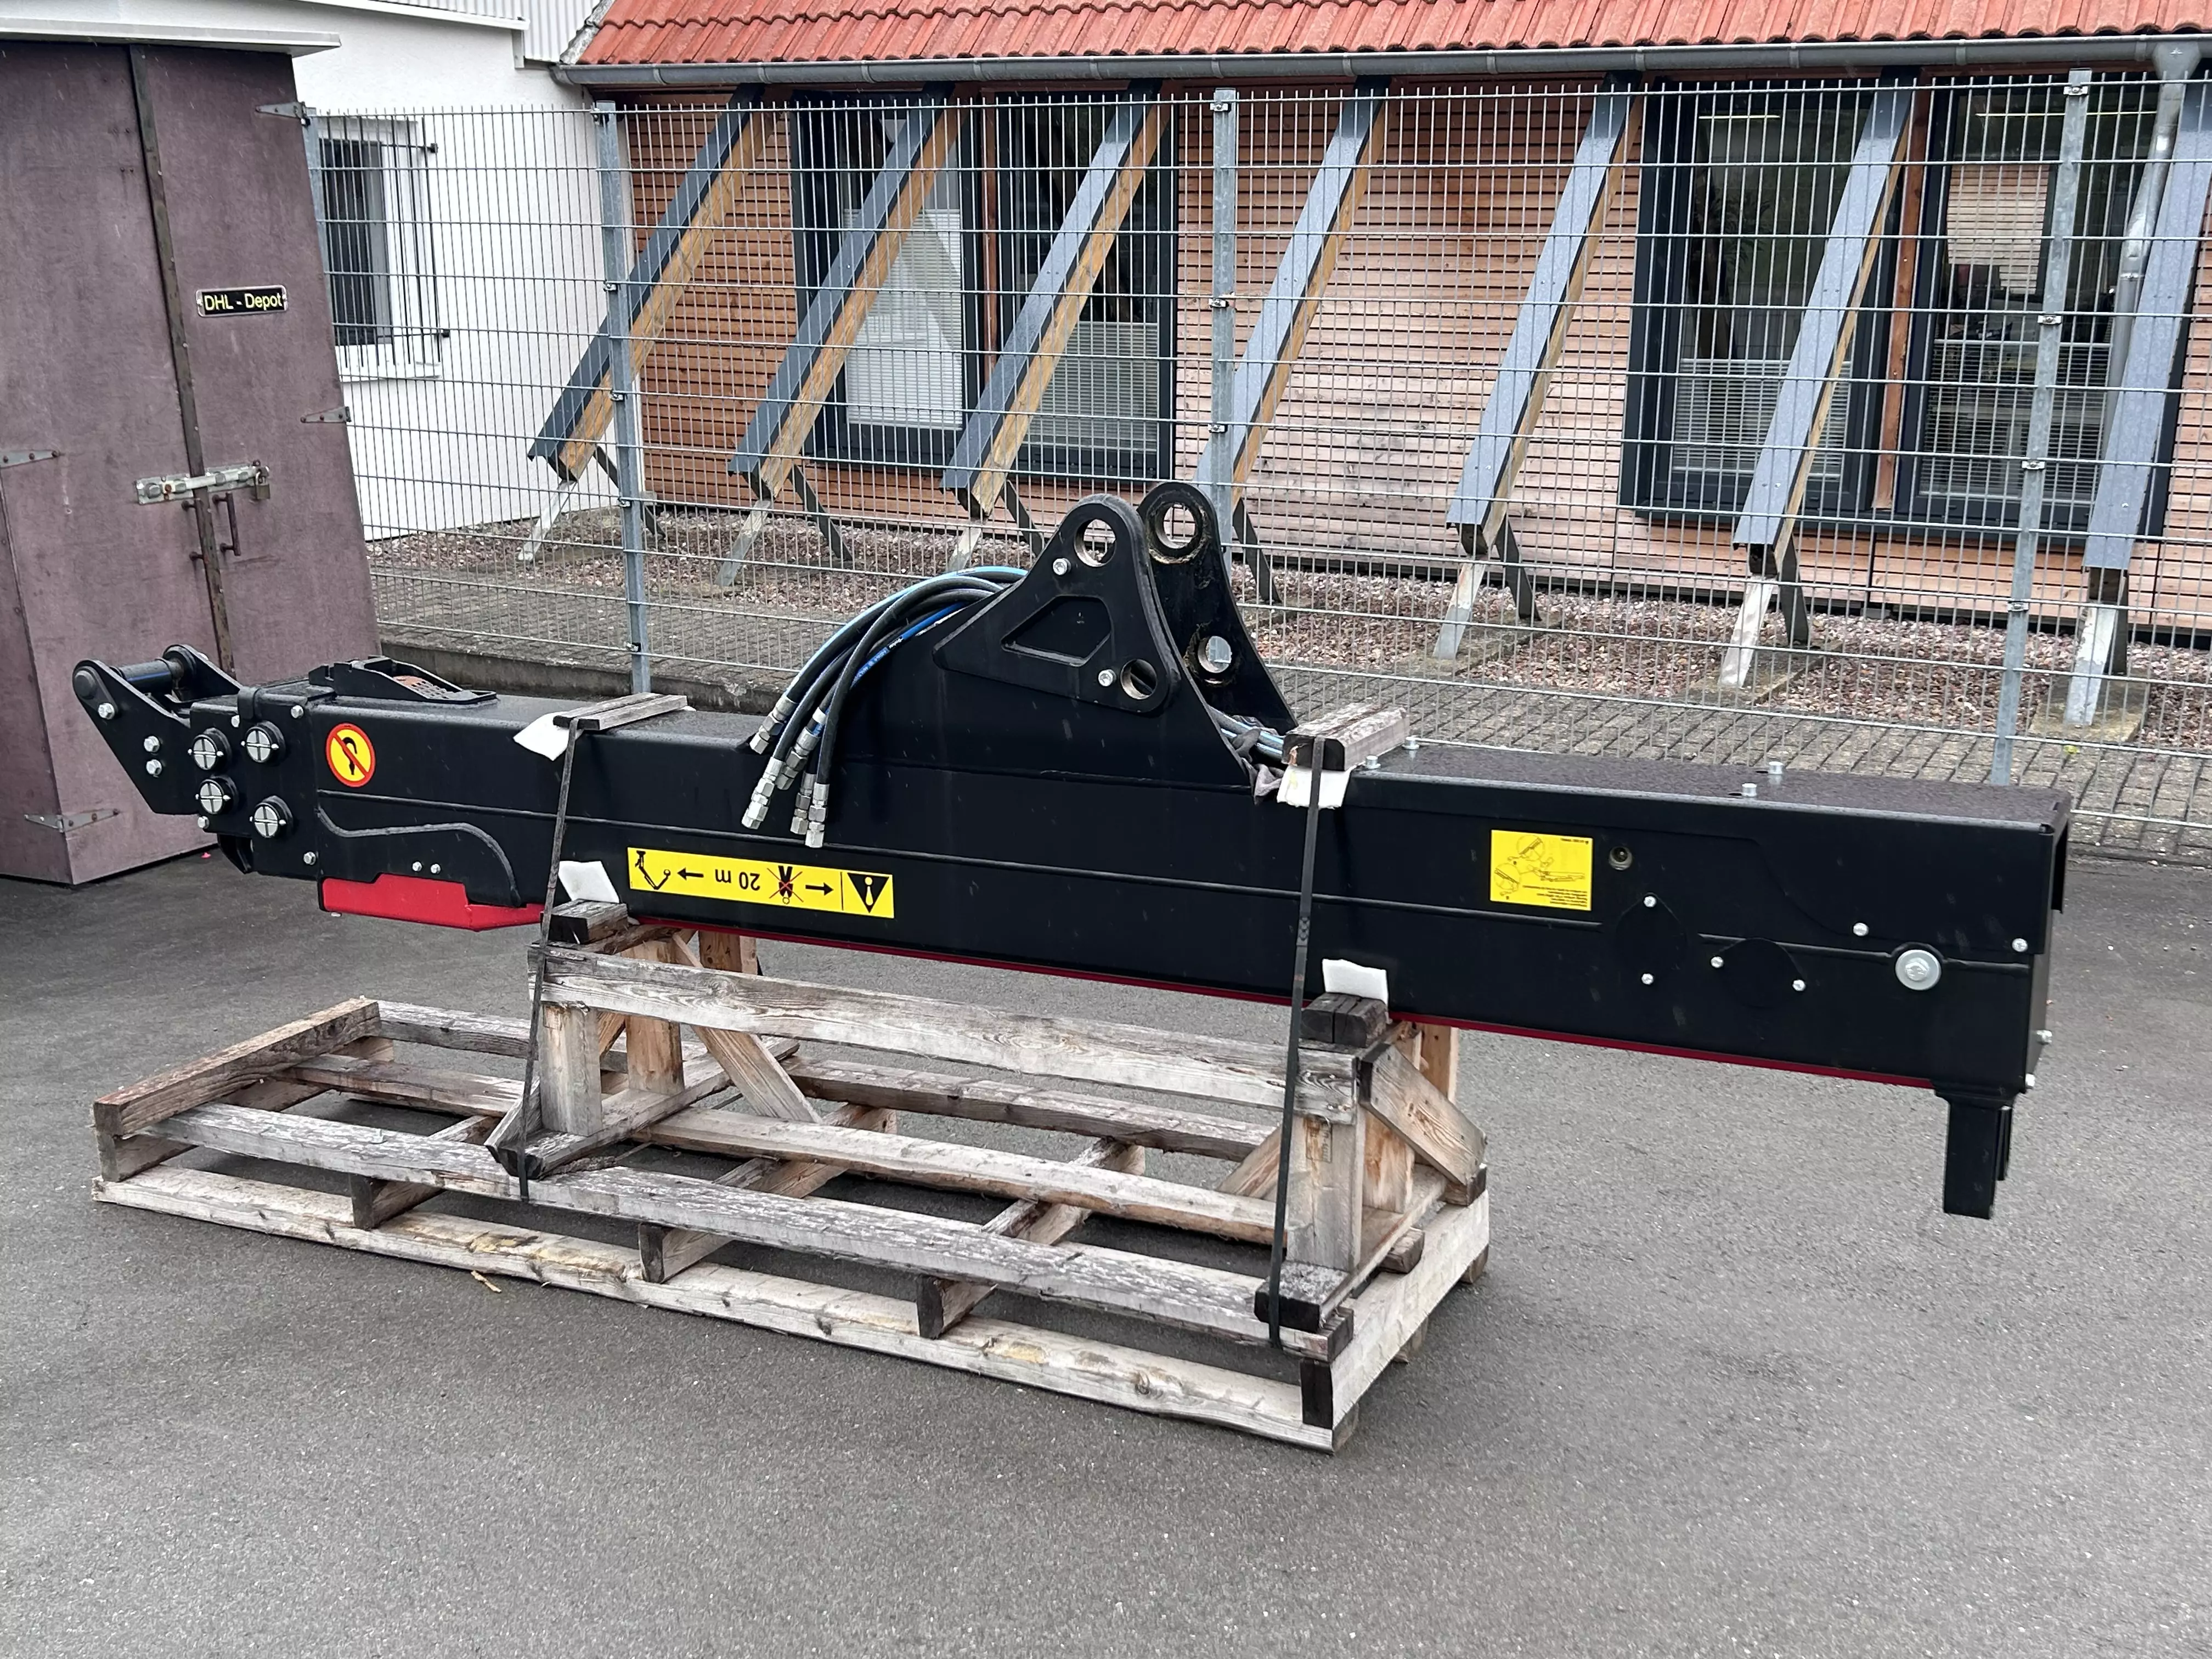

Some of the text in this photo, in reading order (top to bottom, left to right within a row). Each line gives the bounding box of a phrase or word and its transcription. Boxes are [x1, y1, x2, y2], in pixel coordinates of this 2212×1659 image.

[204, 294, 234, 311] DHL
[244, 292, 283, 311] Depot
[715, 869, 760, 891] 20 m
